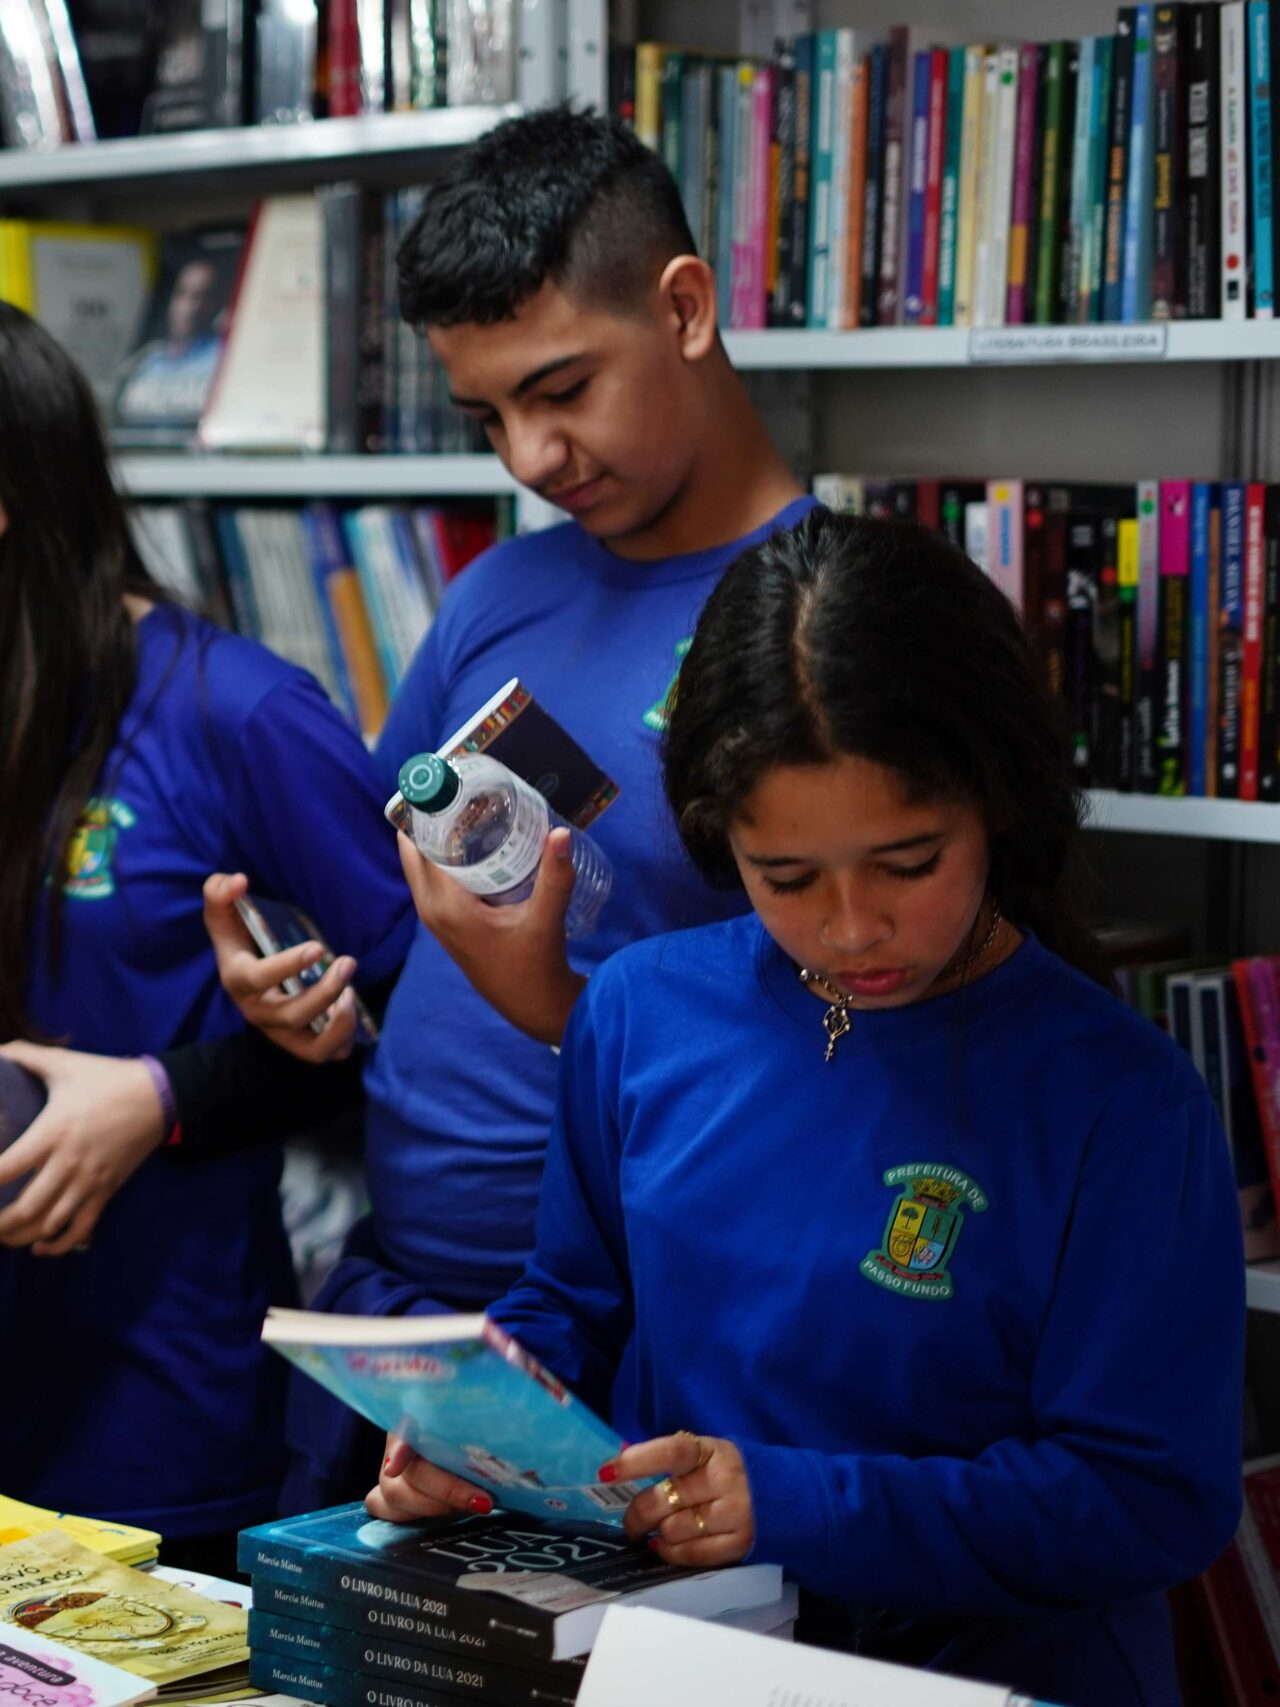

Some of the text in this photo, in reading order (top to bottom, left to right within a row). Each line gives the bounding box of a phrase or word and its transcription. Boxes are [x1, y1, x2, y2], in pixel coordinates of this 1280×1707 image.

[1068, 333, 1158, 348] BRASILEIRA
[1224, 489, 1241, 612] DANIEL SILVA
[887, 1164, 985, 1209] PREFEITURA DE
[863, 1260, 951, 1297] PASSO FUNDO
[429, 1530, 564, 1562] LUA
[467, 1536, 628, 1575] 2021
[257, 1552, 303, 1574] Marcia Mattos
[12, 1568, 84, 1592] mundo
[274, 1589, 325, 1610] Marcia Mattos
[340, 1575, 448, 1617] O LIVRO DA LUA 2021
[270, 1628, 321, 1649] Marcia Mattos
[368, 1610, 378, 1623] O
[380, 1613, 414, 1631] LIVRO
[416, 1619, 432, 1636] DA
[434, 1624, 456, 1641] LUA
[3, 1654, 66, 1684] aventura
[272, 1668, 324, 1690] Marcia Mattos
[365, 1650, 484, 1689] O LIVRO DA LUA 2021
[367, 1690, 377, 1703] O
[380, 1692, 413, 1707] LIVRO
